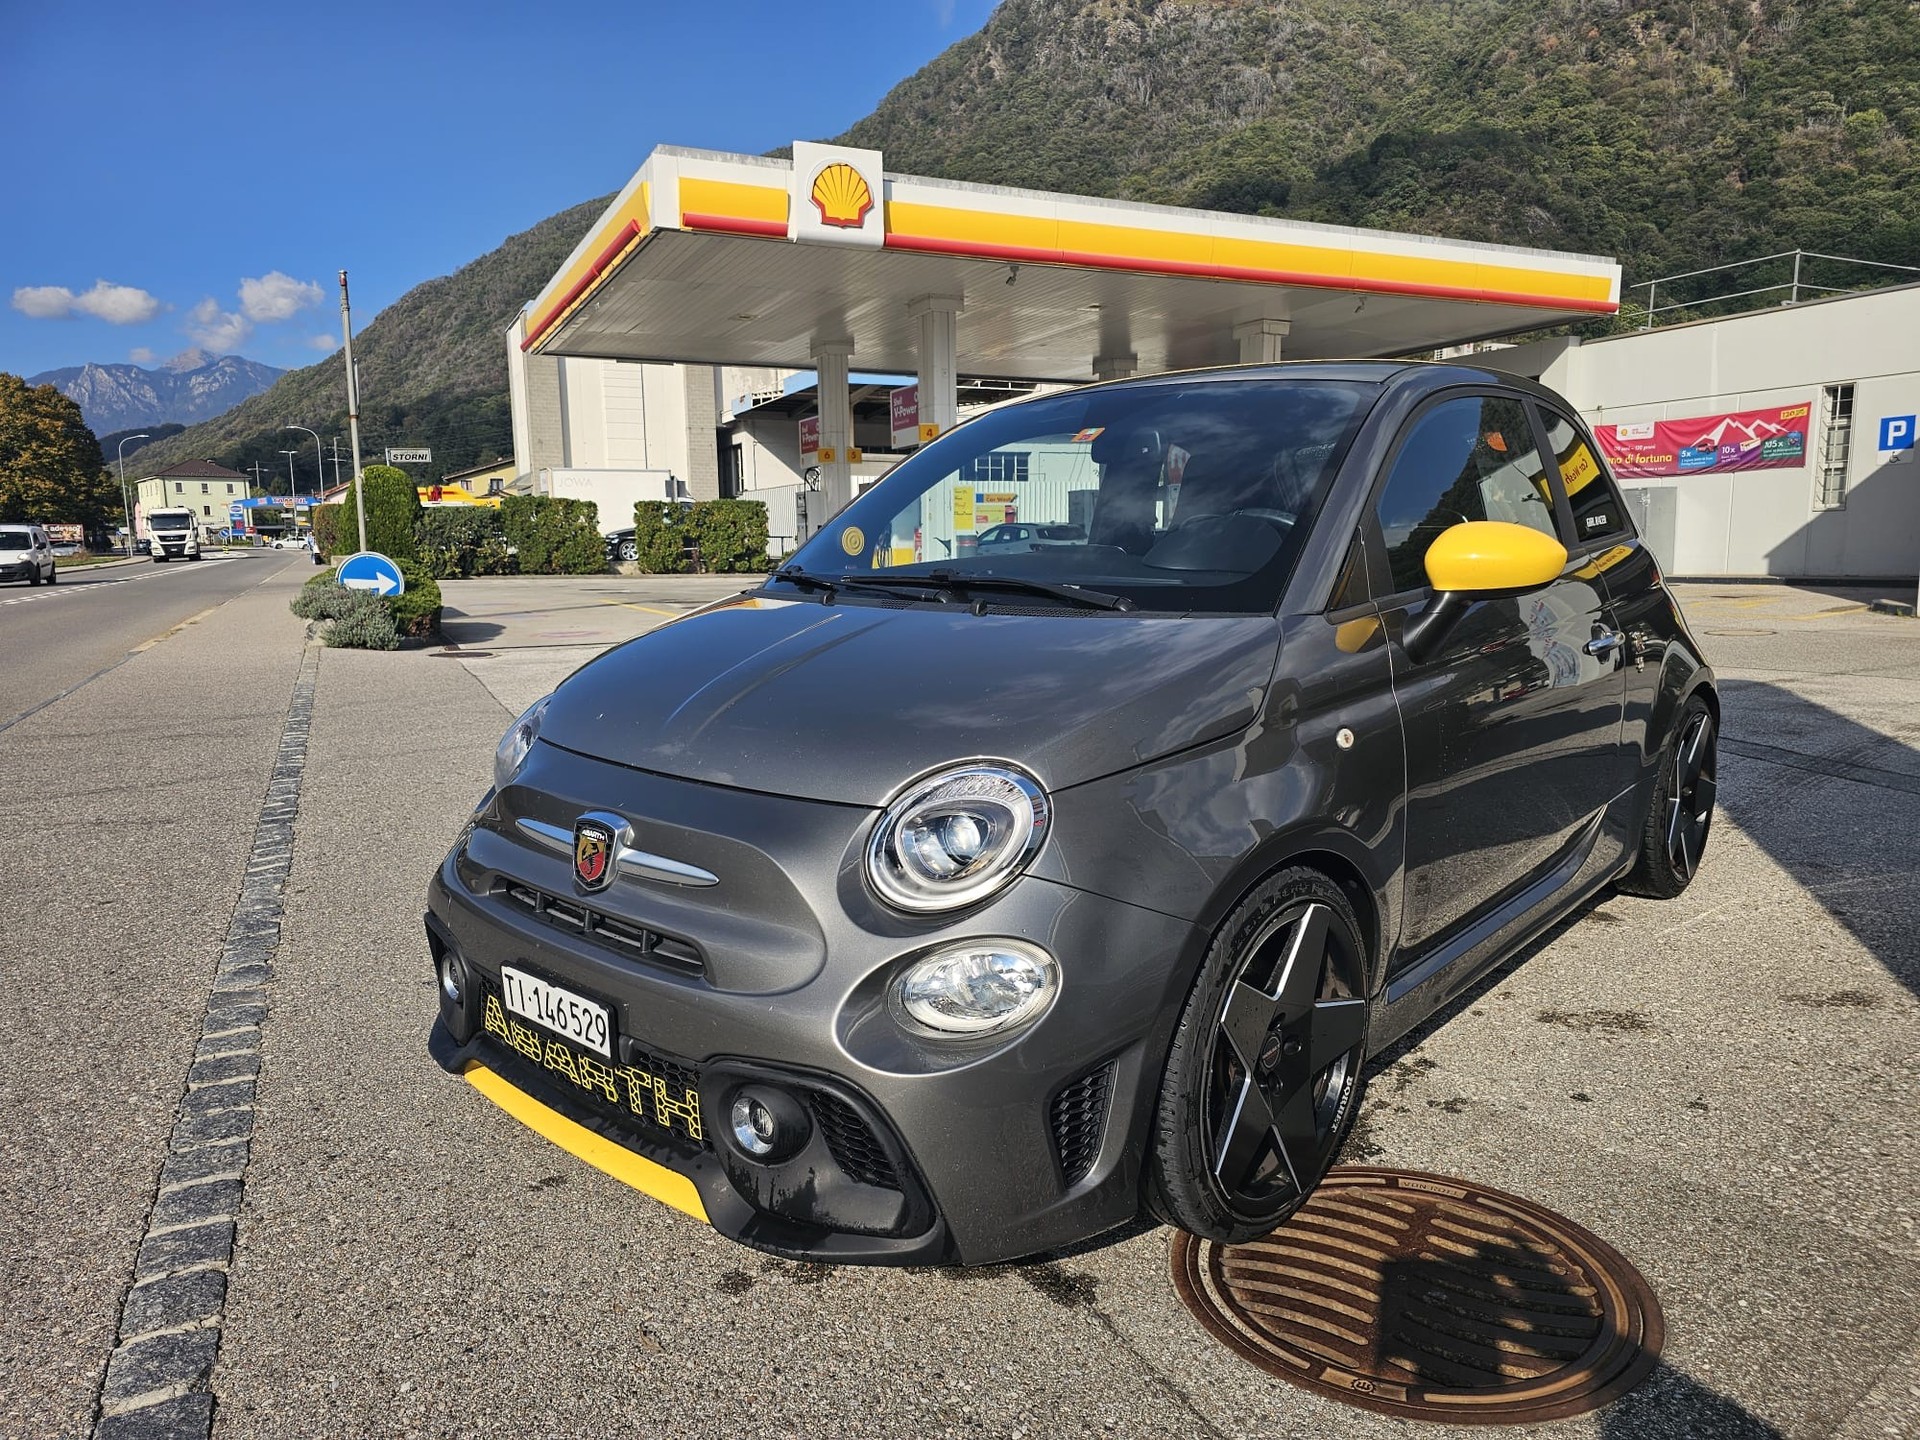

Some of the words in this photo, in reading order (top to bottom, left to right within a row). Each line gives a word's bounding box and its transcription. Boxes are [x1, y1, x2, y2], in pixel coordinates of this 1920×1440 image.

[893, 405, 918, 418] V-Power
[926, 428, 933, 437] 4
[1887, 420, 1907, 446] P
[392, 453, 428, 461] STORNI
[824, 451, 831, 460] 6
[851, 451, 857, 460] 5
[1625, 453, 1633, 464] di
[1635, 452, 1672, 464] fortuna
[581, 829, 605, 840] ABARTH
[485, 995, 702, 1140] ABARTH
